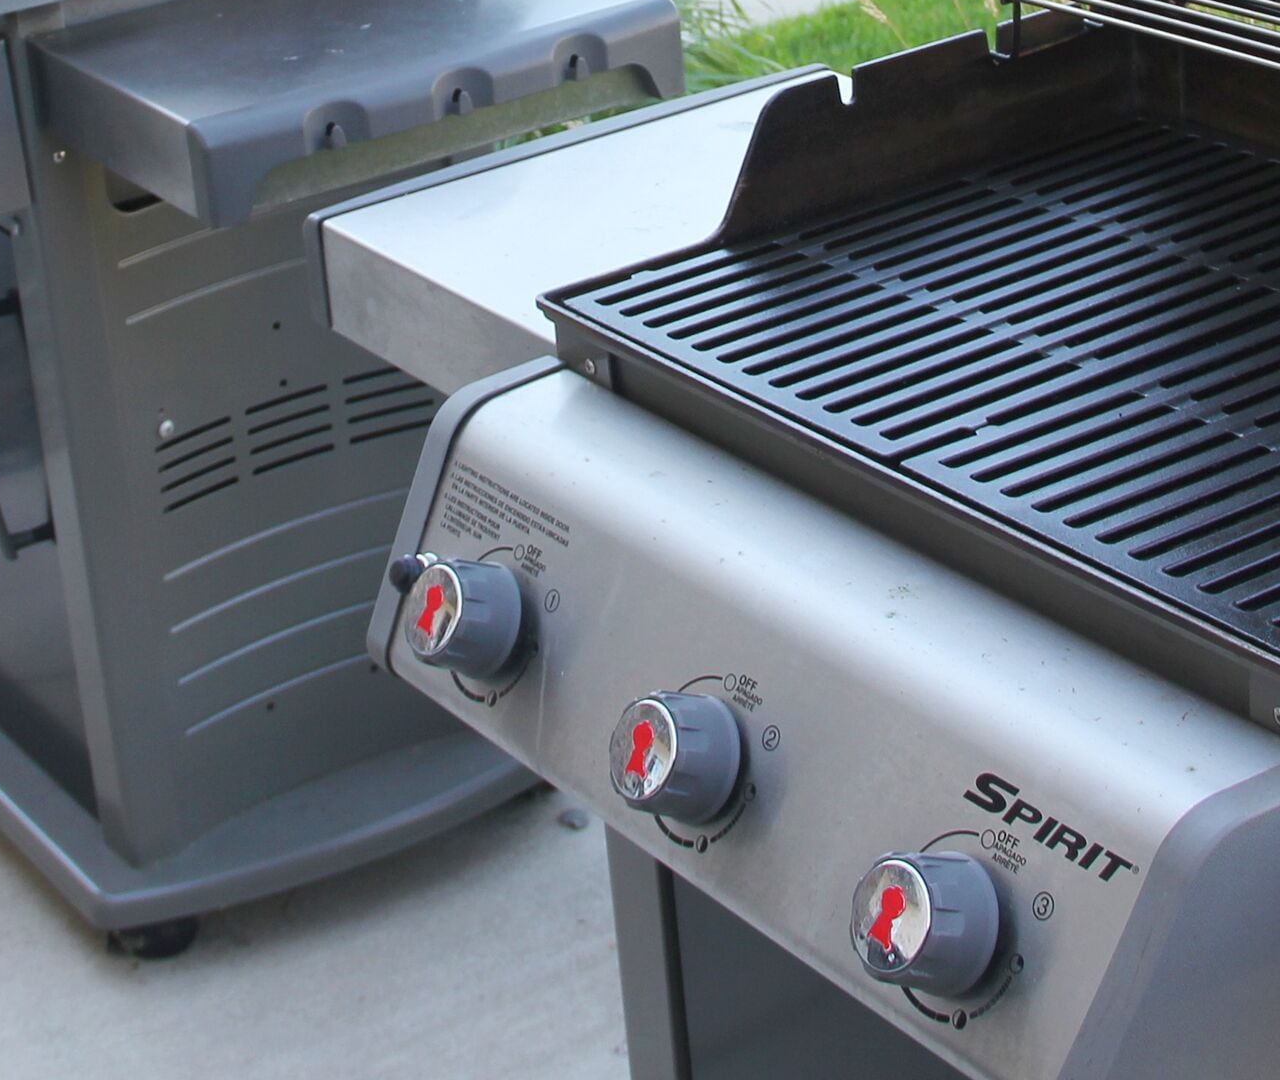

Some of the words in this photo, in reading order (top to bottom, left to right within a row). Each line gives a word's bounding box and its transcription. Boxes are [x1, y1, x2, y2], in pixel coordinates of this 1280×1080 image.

[526, 543, 543, 559] OFF
[739, 674, 758, 691] OFF
[736, 685, 763, 706] APAGADO
[962, 771, 1134, 883] SPIRIT
[997, 829, 1020, 850] OFF
[994, 842, 1027, 866] APAGADO
